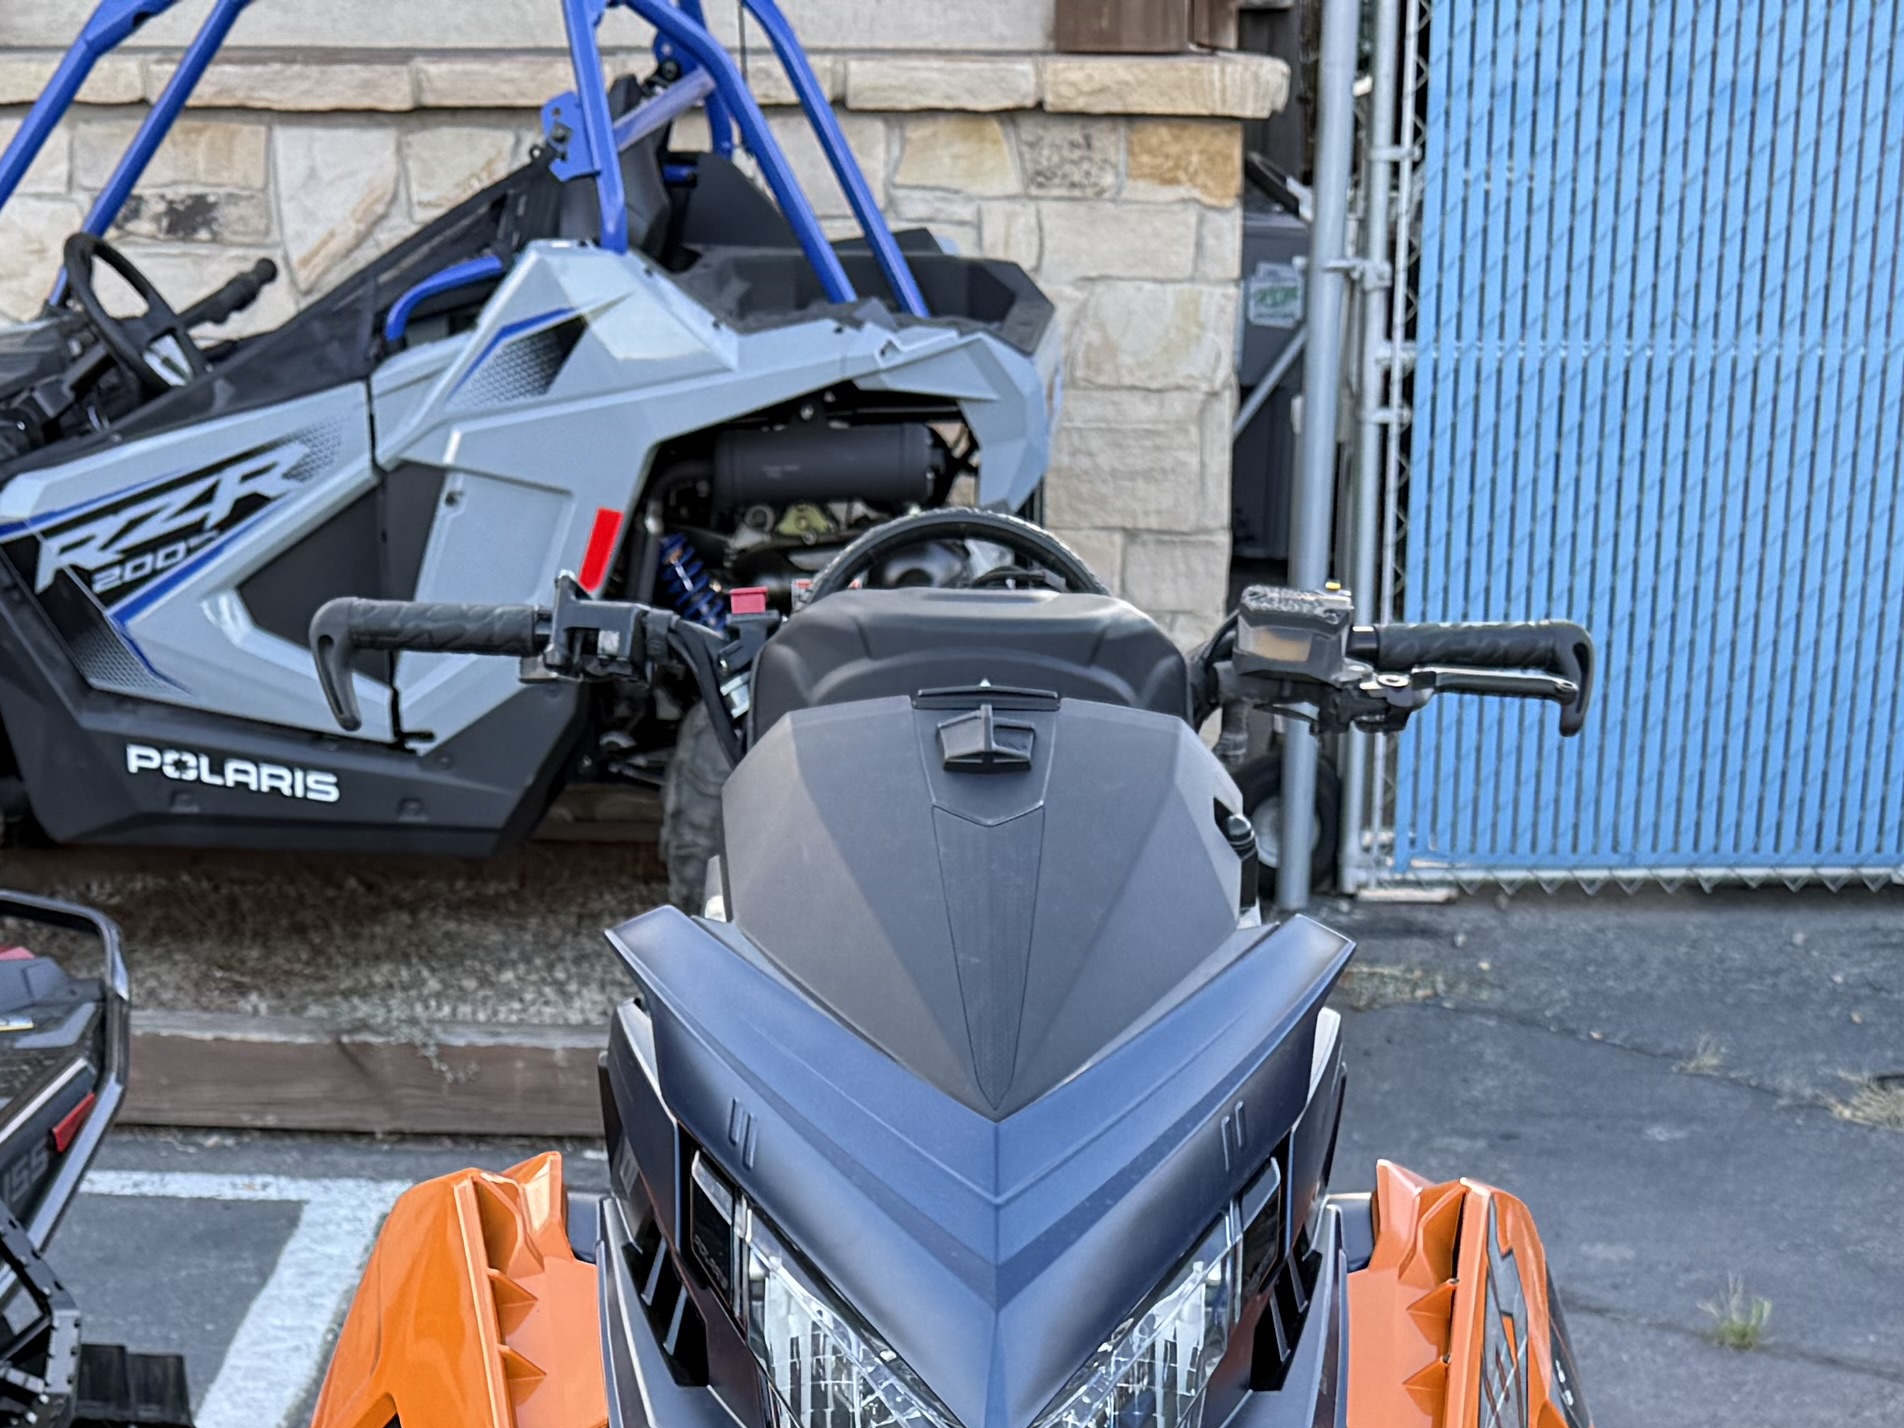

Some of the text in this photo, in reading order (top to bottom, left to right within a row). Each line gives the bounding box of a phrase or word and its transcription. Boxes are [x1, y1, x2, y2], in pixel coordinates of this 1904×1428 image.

[35, 440, 310, 594] RZR
[92, 545, 187, 593] 200
[126, 744, 340, 803] POLARIS
